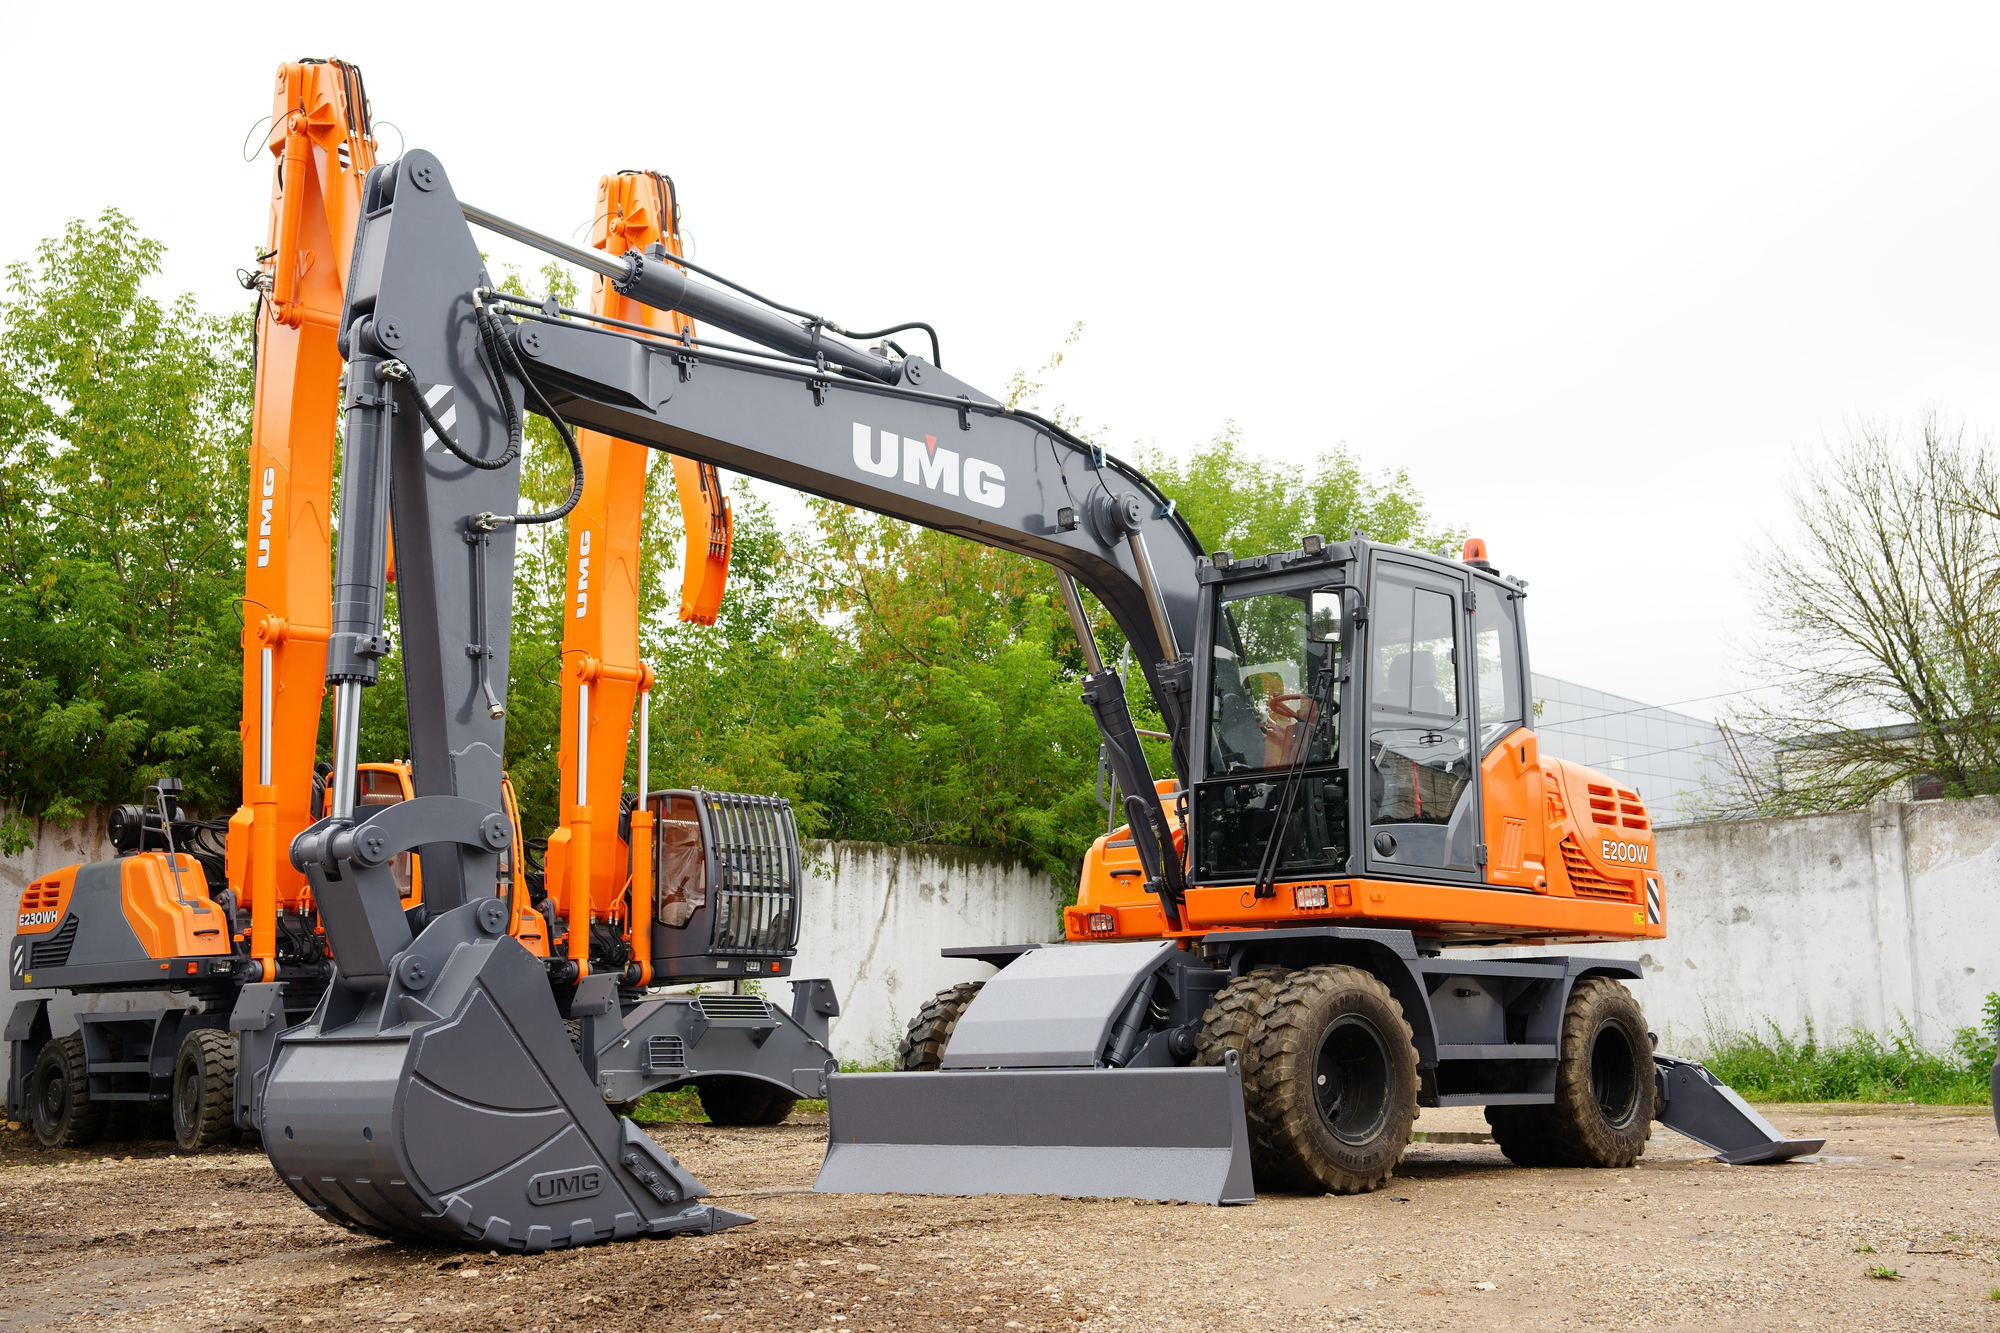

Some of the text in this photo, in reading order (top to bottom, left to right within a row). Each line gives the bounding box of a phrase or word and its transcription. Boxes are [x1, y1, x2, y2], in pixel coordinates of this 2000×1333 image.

[852, 421, 1006, 509] UMG
[257, 466, 275, 568] UMG
[575, 528, 591, 619] UMG
[1601, 839, 1649, 865] E200W
[18, 910, 58, 927] E230WH
[536, 1172, 599, 1198] UMG
